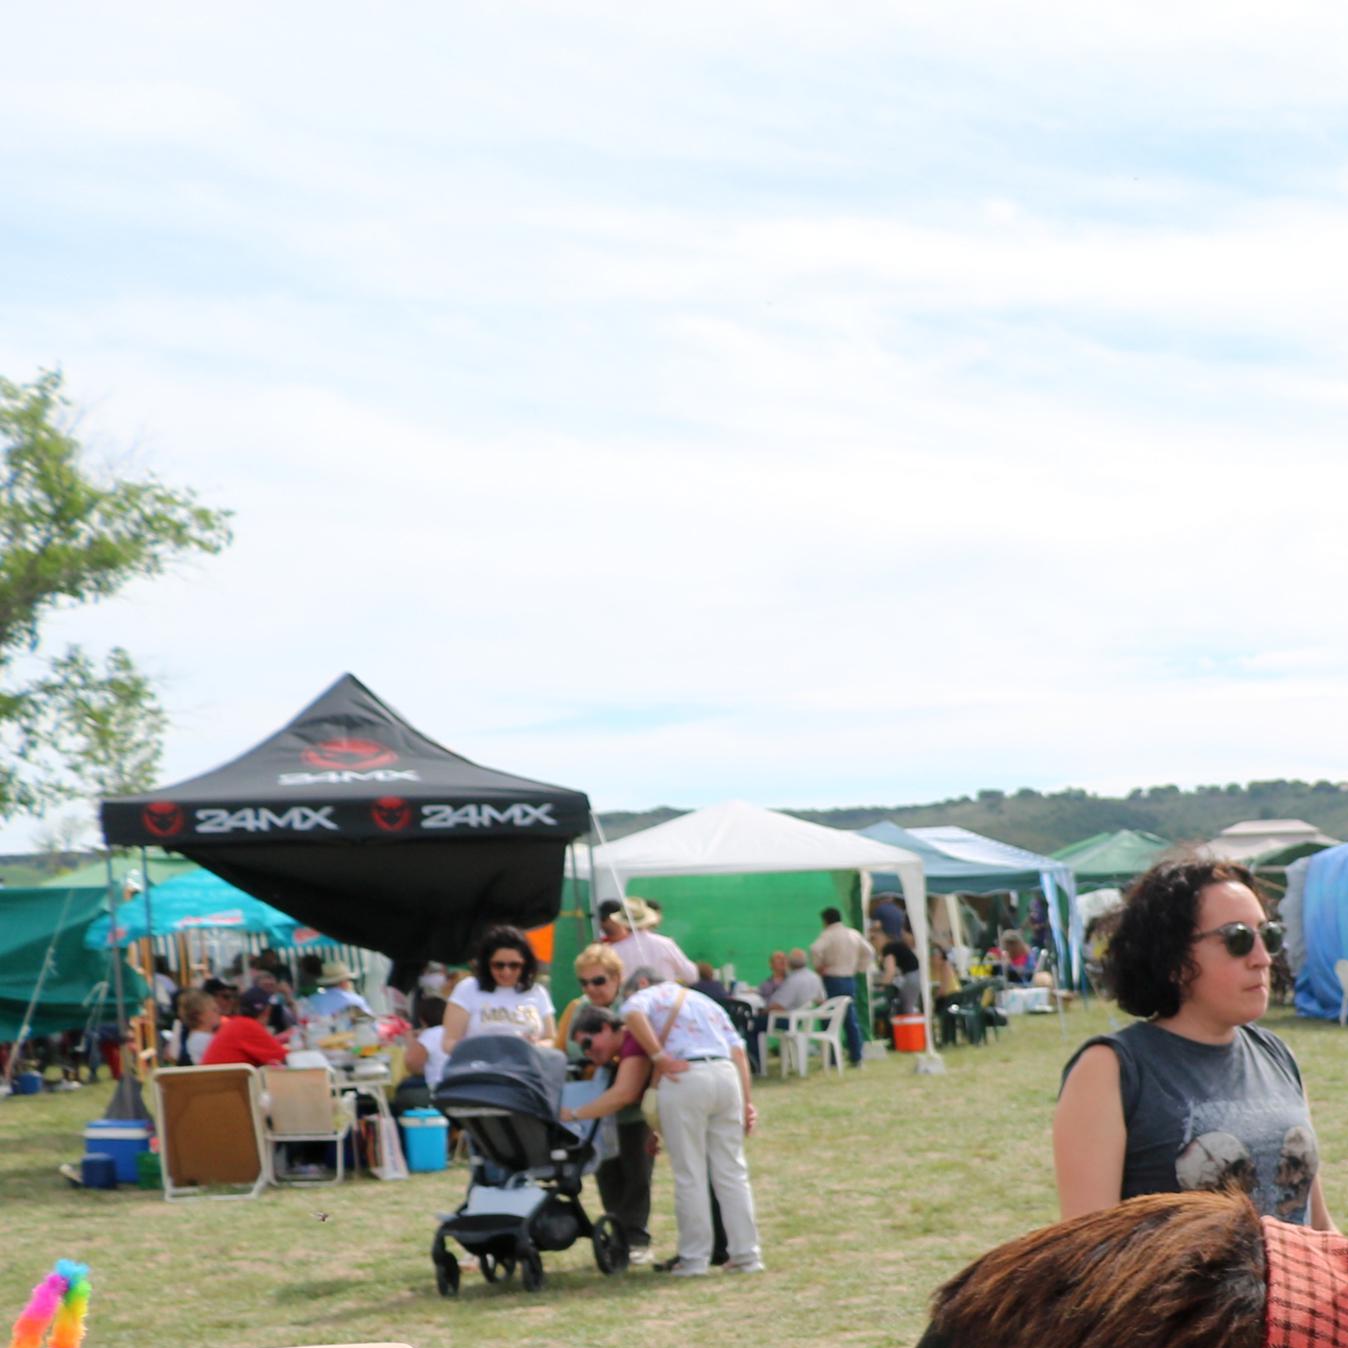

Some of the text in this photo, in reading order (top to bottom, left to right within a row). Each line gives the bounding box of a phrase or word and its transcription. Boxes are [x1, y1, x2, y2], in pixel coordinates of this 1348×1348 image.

[277, 769, 421, 786] 24MX
[195, 806, 339, 833] 24MX
[420, 802, 557, 829] 24MX
